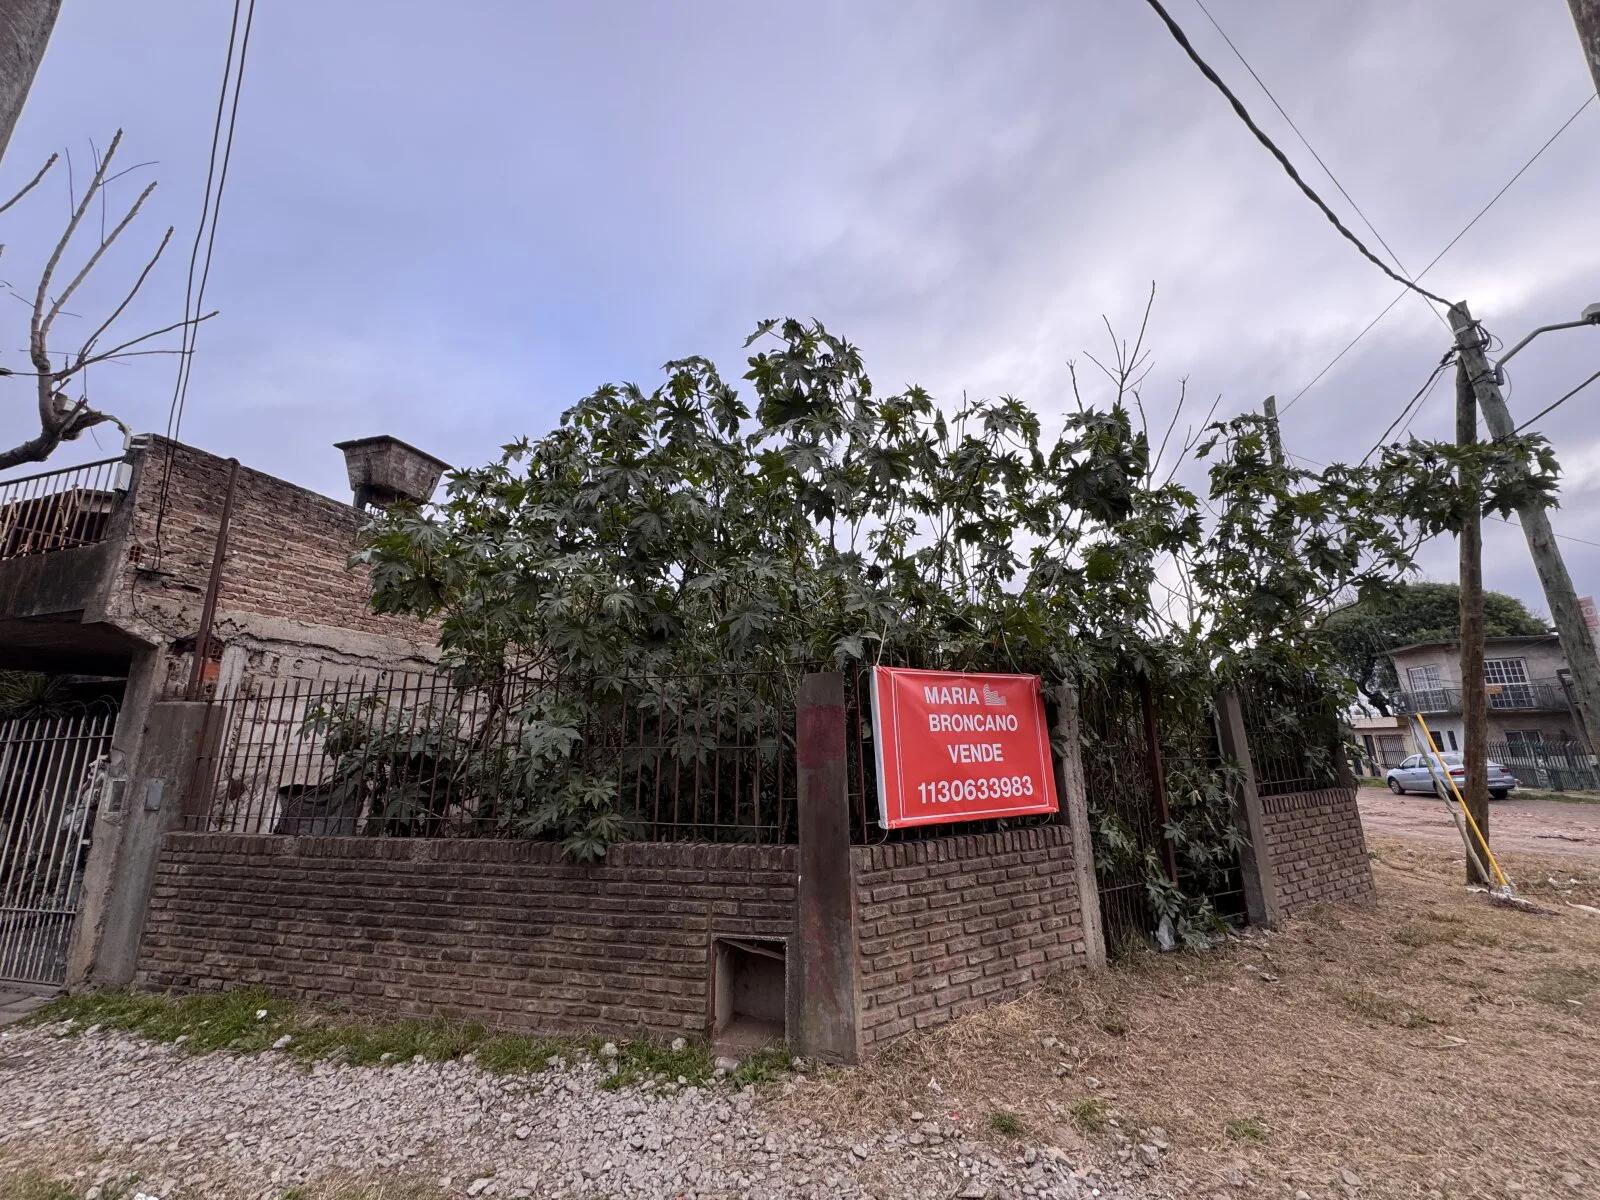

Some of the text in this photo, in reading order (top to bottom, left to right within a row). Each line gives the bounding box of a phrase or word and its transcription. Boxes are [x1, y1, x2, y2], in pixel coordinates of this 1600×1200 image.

[924, 686, 980, 705] MARIA
[928, 713, 1018, 732] BRONCANO
[947, 743, 1004, 763] VENDE
[917, 775, 1034, 804] 1130633983
